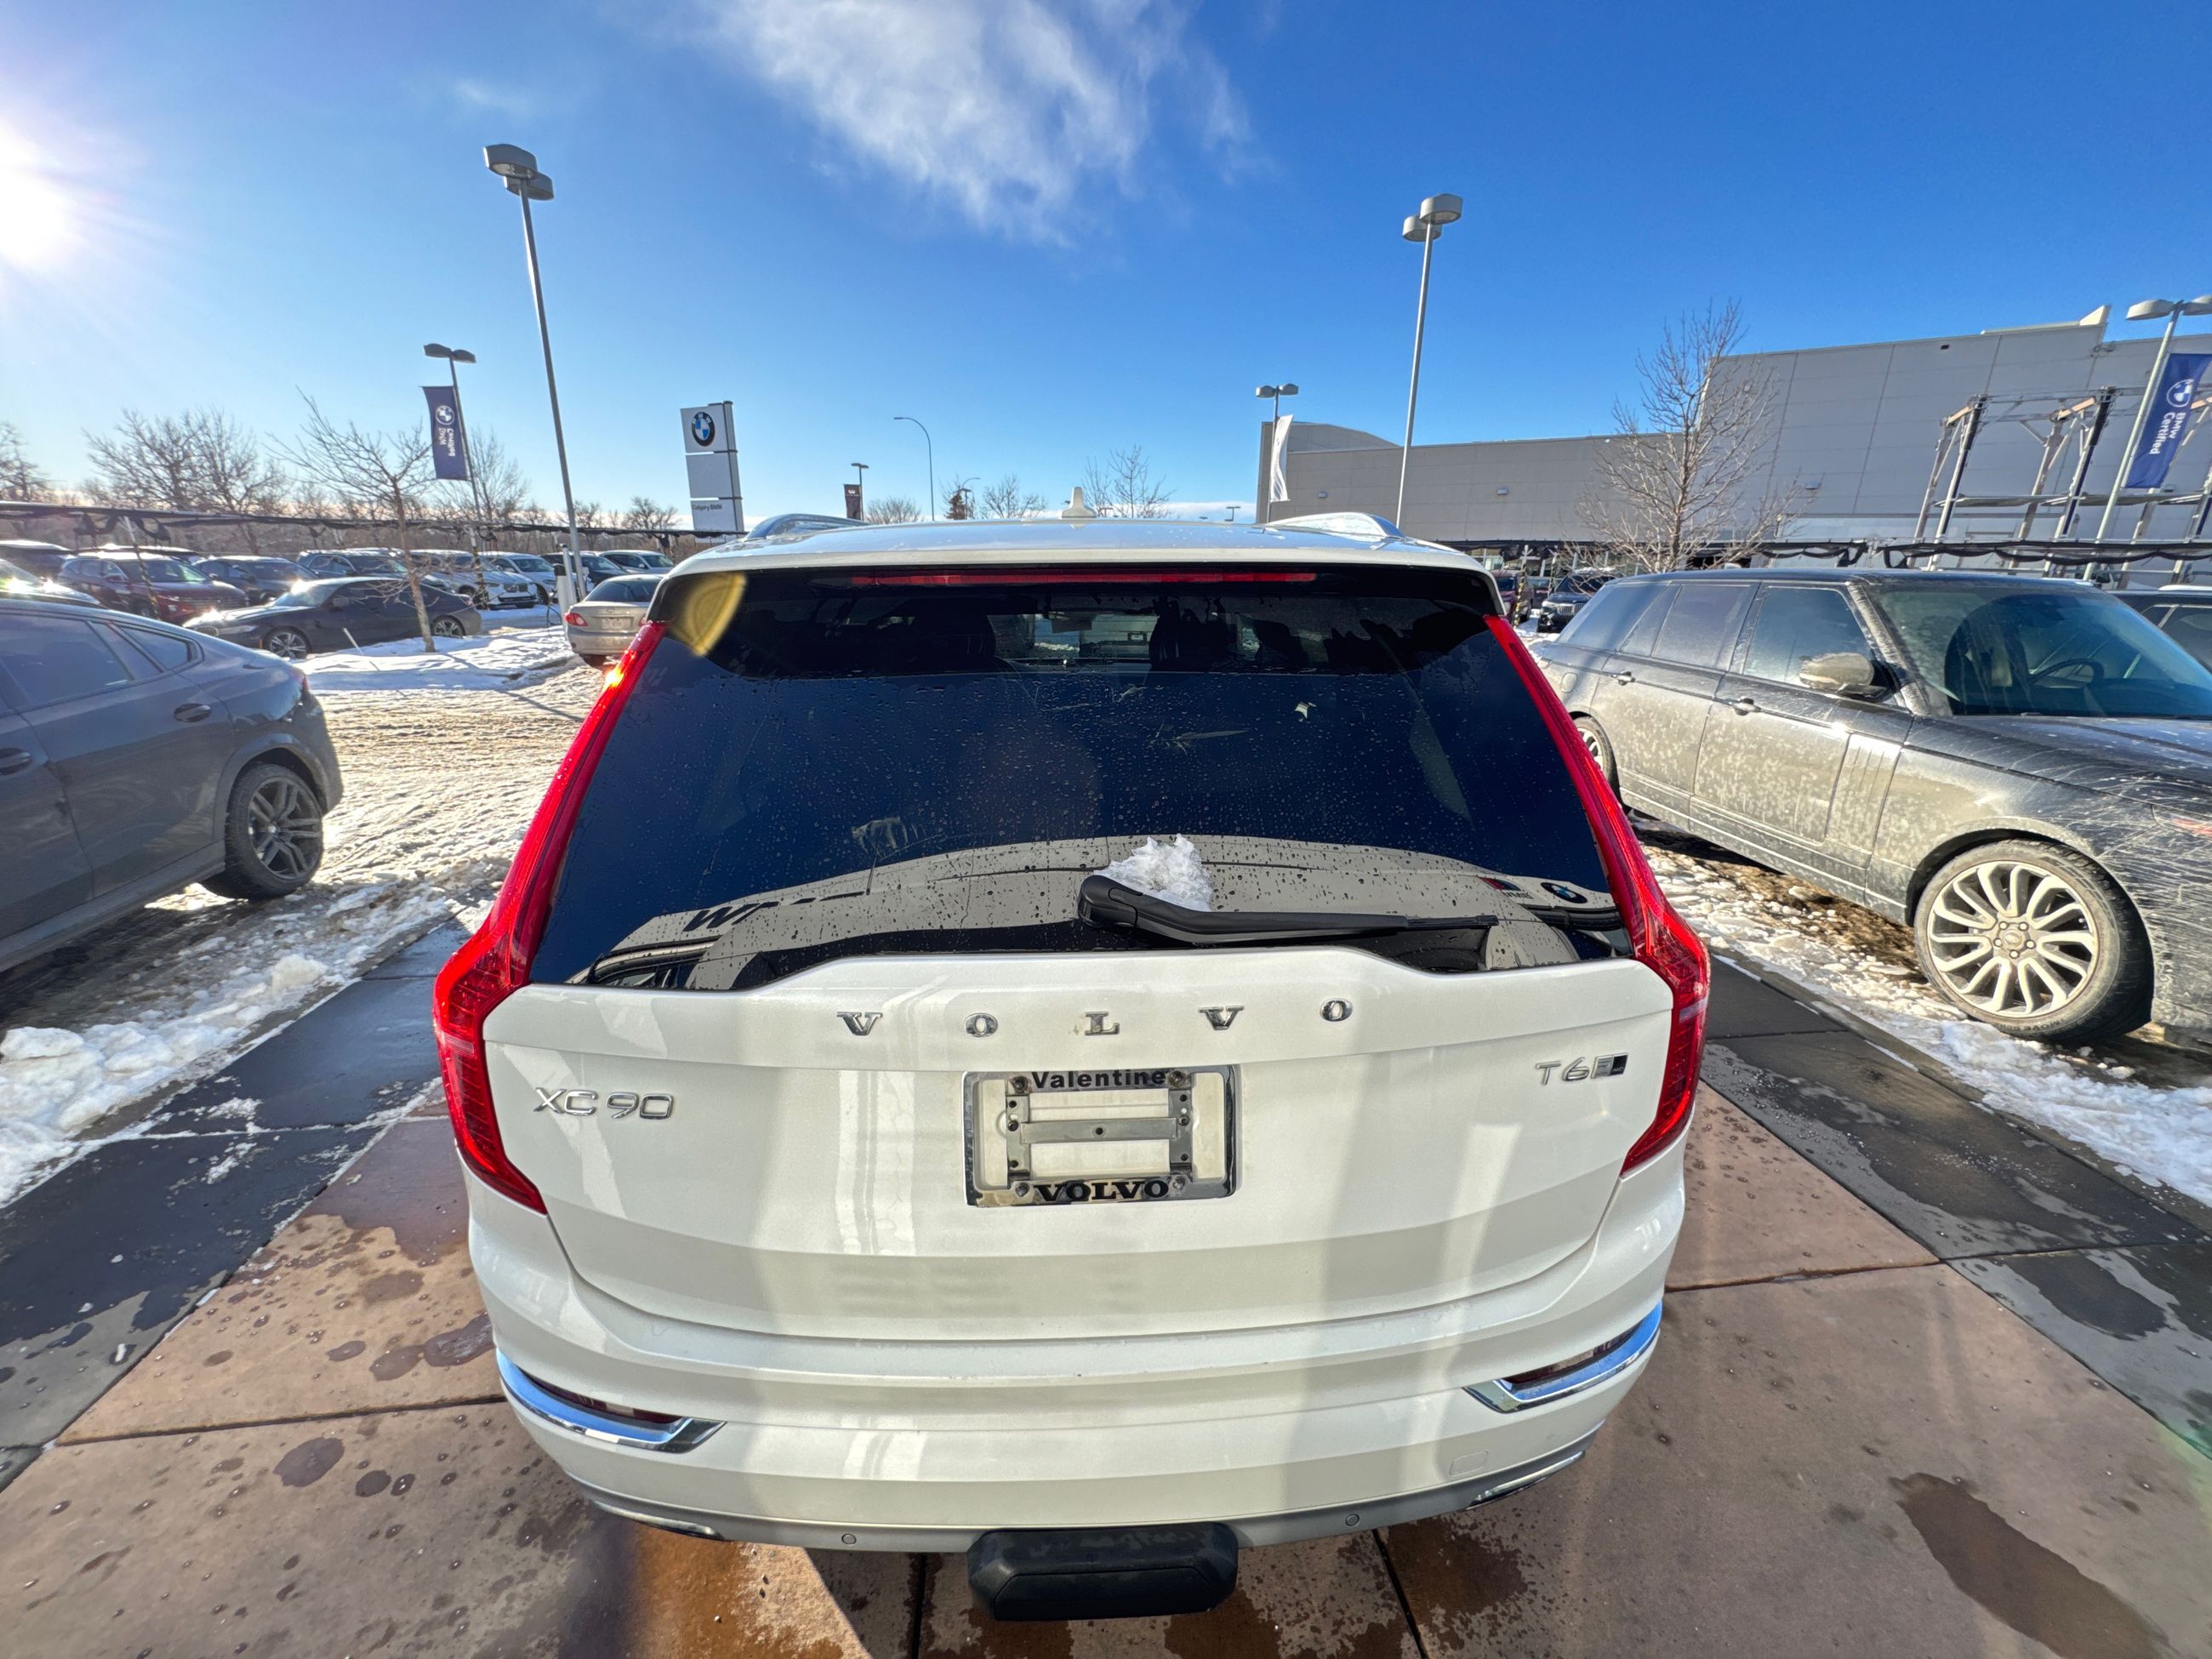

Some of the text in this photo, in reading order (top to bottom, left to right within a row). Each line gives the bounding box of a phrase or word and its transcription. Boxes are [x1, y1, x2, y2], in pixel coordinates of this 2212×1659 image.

[2149, 412, 2175, 455] Certified
[2169, 412, 2186, 439] BMW
[835, 998, 1354, 1038] VOLVO
[1031, 1069, 1166, 1090] Valentine
[1535, 1057, 1590, 1086] T6
[1034, 1180, 1170, 1202] VOLVO
